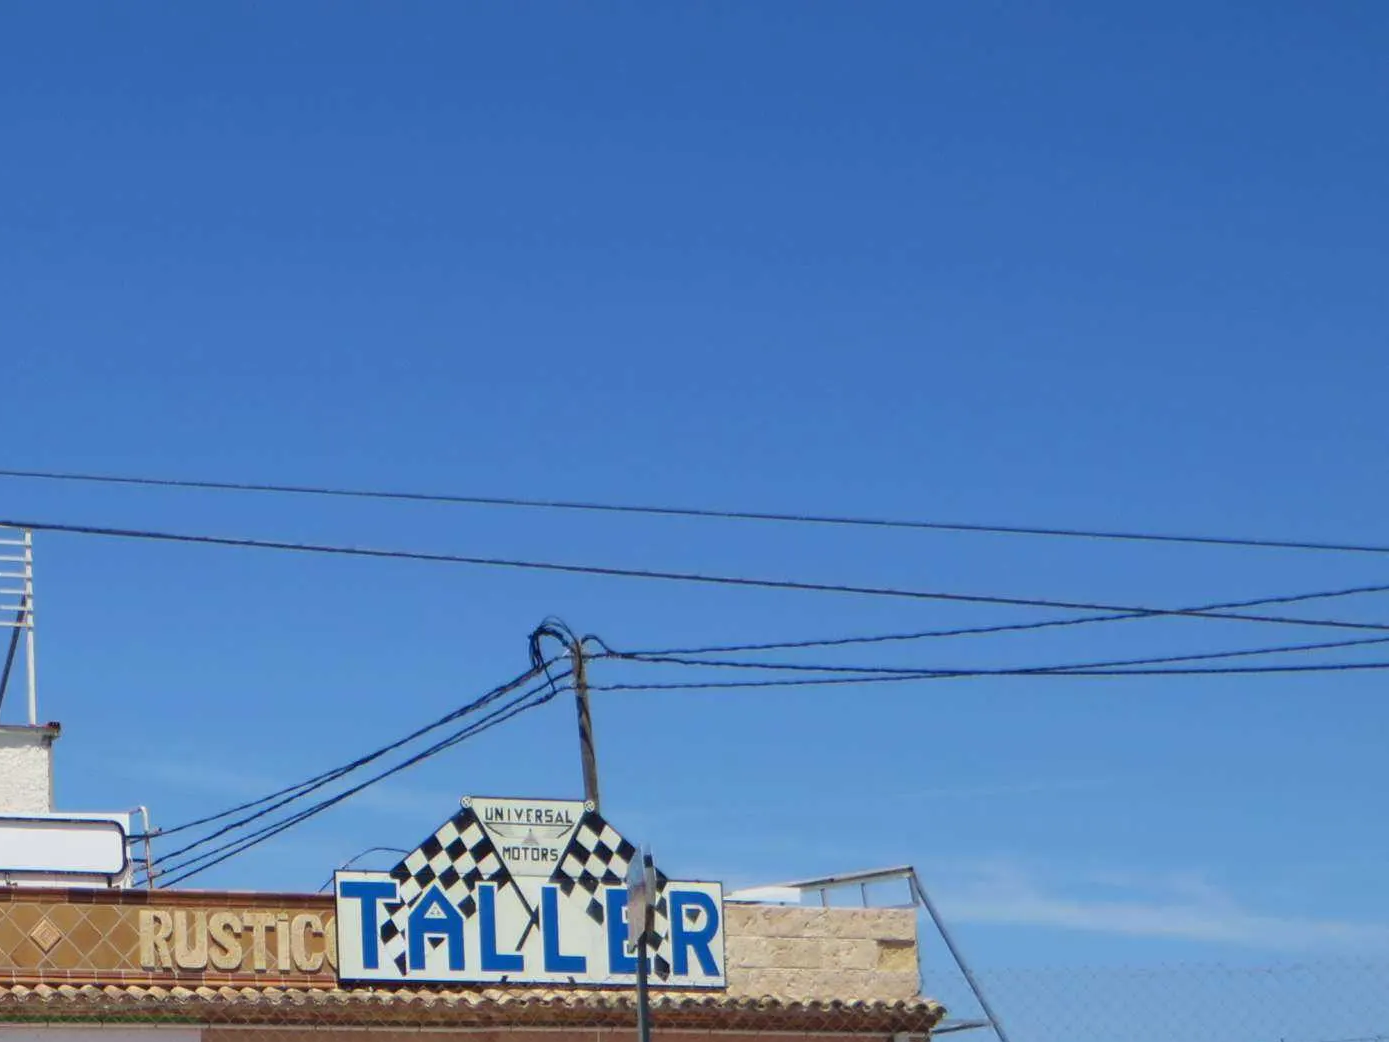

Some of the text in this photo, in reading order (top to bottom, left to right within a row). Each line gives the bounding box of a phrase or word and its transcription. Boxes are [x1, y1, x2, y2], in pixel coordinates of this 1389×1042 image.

[485, 807, 573, 824] UNIVERSAL
[502, 845, 559, 862] MOTORS
[340, 880, 720, 977] TALLER
